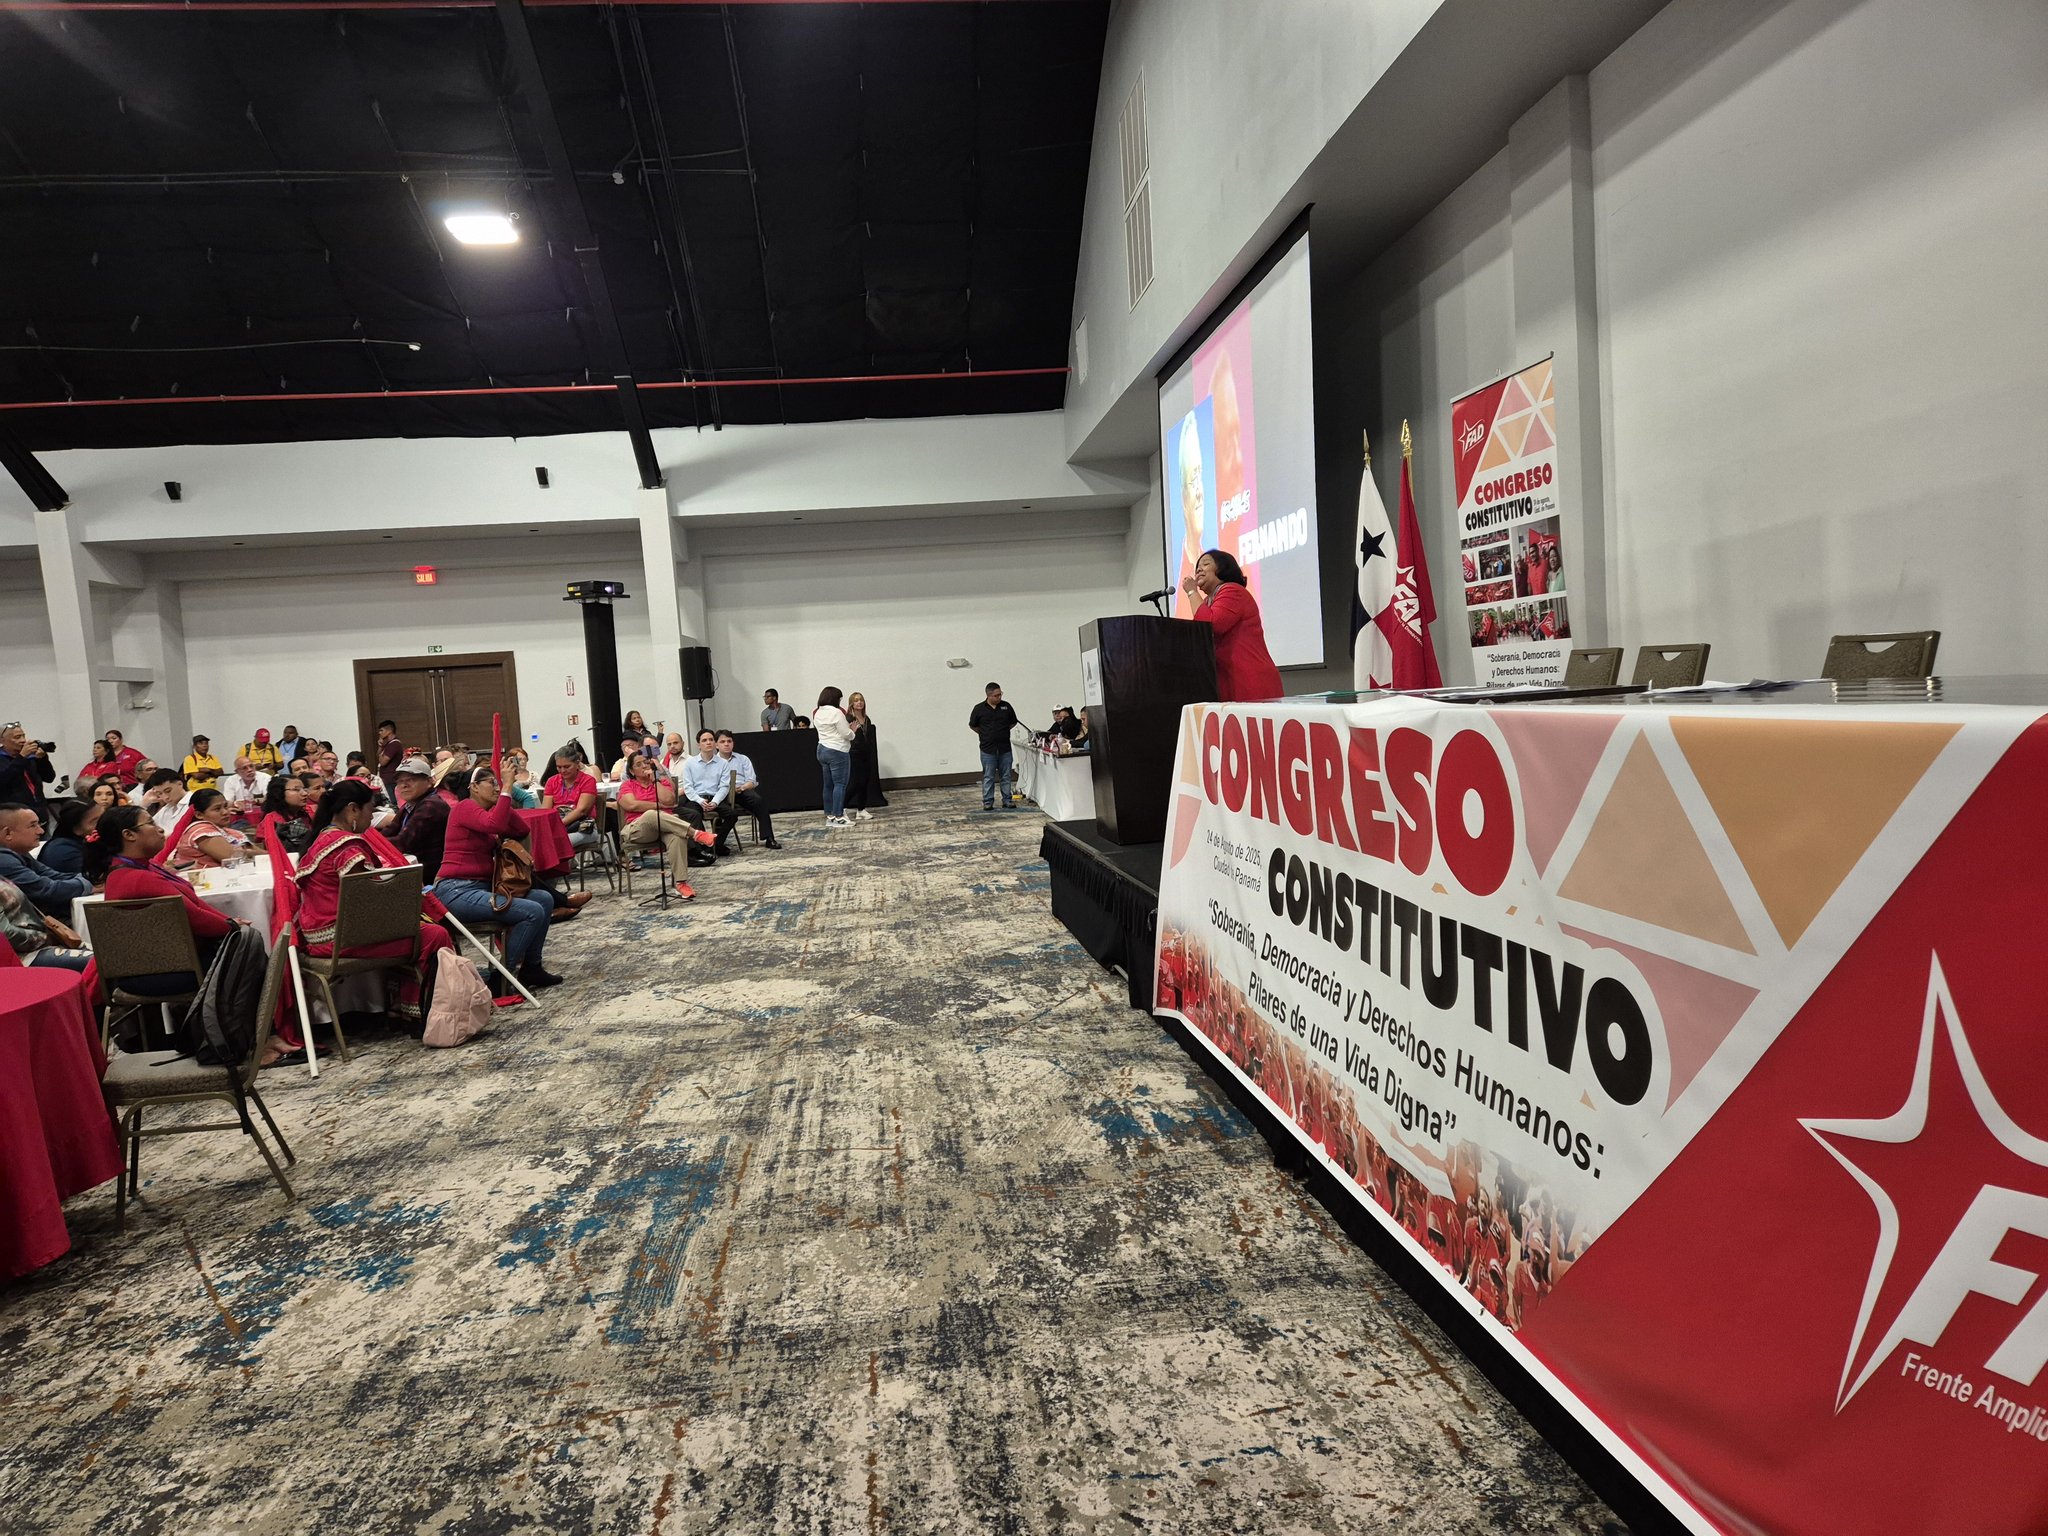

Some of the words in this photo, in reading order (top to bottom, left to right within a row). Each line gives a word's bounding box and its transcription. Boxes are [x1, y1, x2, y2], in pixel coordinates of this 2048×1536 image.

[1464, 423, 1485, 451] FAD
[1474, 463, 1552, 505] CONGRESO
[1465, 495, 1533, 531] CONSTITUTIVO
[1238, 506, 1308, 567] FERNANDO
[1491, 669, 1496, 678] y
[1496, 666, 1524, 676] Derechos
[1525, 665, 1560, 675] Humanos:
[1522, 648, 1561, 660] Democracia
[1202, 711, 1515, 897] CONGRESO
[1213, 833, 1221, 848] de
[1234, 843, 1244, 860] de
[1235, 866, 1262, 893] Panamá
[1267, 847, 1653, 1107] CONSTITUTIVO
[1208, 897, 1257, 960] “Soberanía,
[1260, 932, 1342, 1008] Democracia
[1343, 988, 1357, 1022] y
[1358, 989, 1447, 1079] Derechos
[1454, 1048, 1605, 1180] Humanos:
[1248, 970, 1287, 1024] Pilares
[1290, 1004, 1306, 1039] de
[1310, 1023, 1338, 1063] una
[1345, 1036, 1379, 1095] Vida
[1383, 1067, 1457, 1144] Digna”
[1901, 1351, 1973, 1403] Frente
[1973, 1384, 2048, 1442] Amplio
